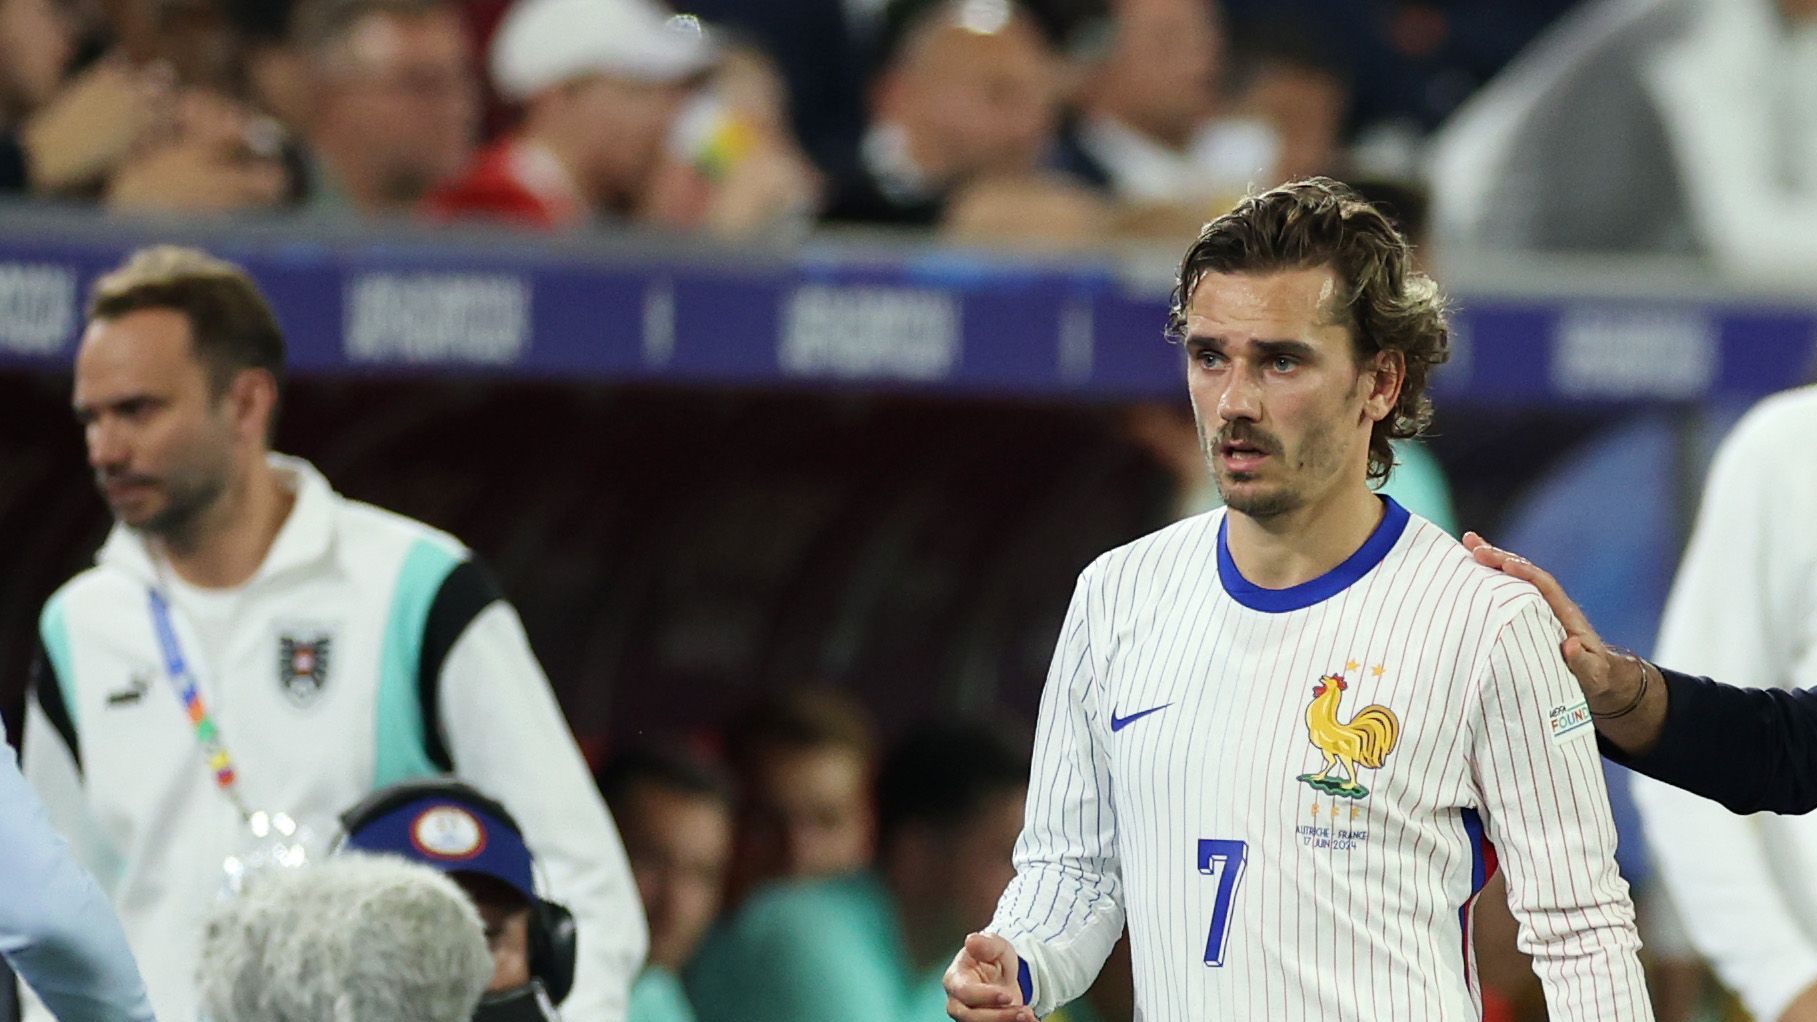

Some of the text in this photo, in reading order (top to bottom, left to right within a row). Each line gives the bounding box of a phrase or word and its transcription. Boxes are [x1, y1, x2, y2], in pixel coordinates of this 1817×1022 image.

[1338, 829, 1368, 841] FRANCE
[1333, 840, 1357, 850] 2024
[1197, 838, 1249, 967] 7
